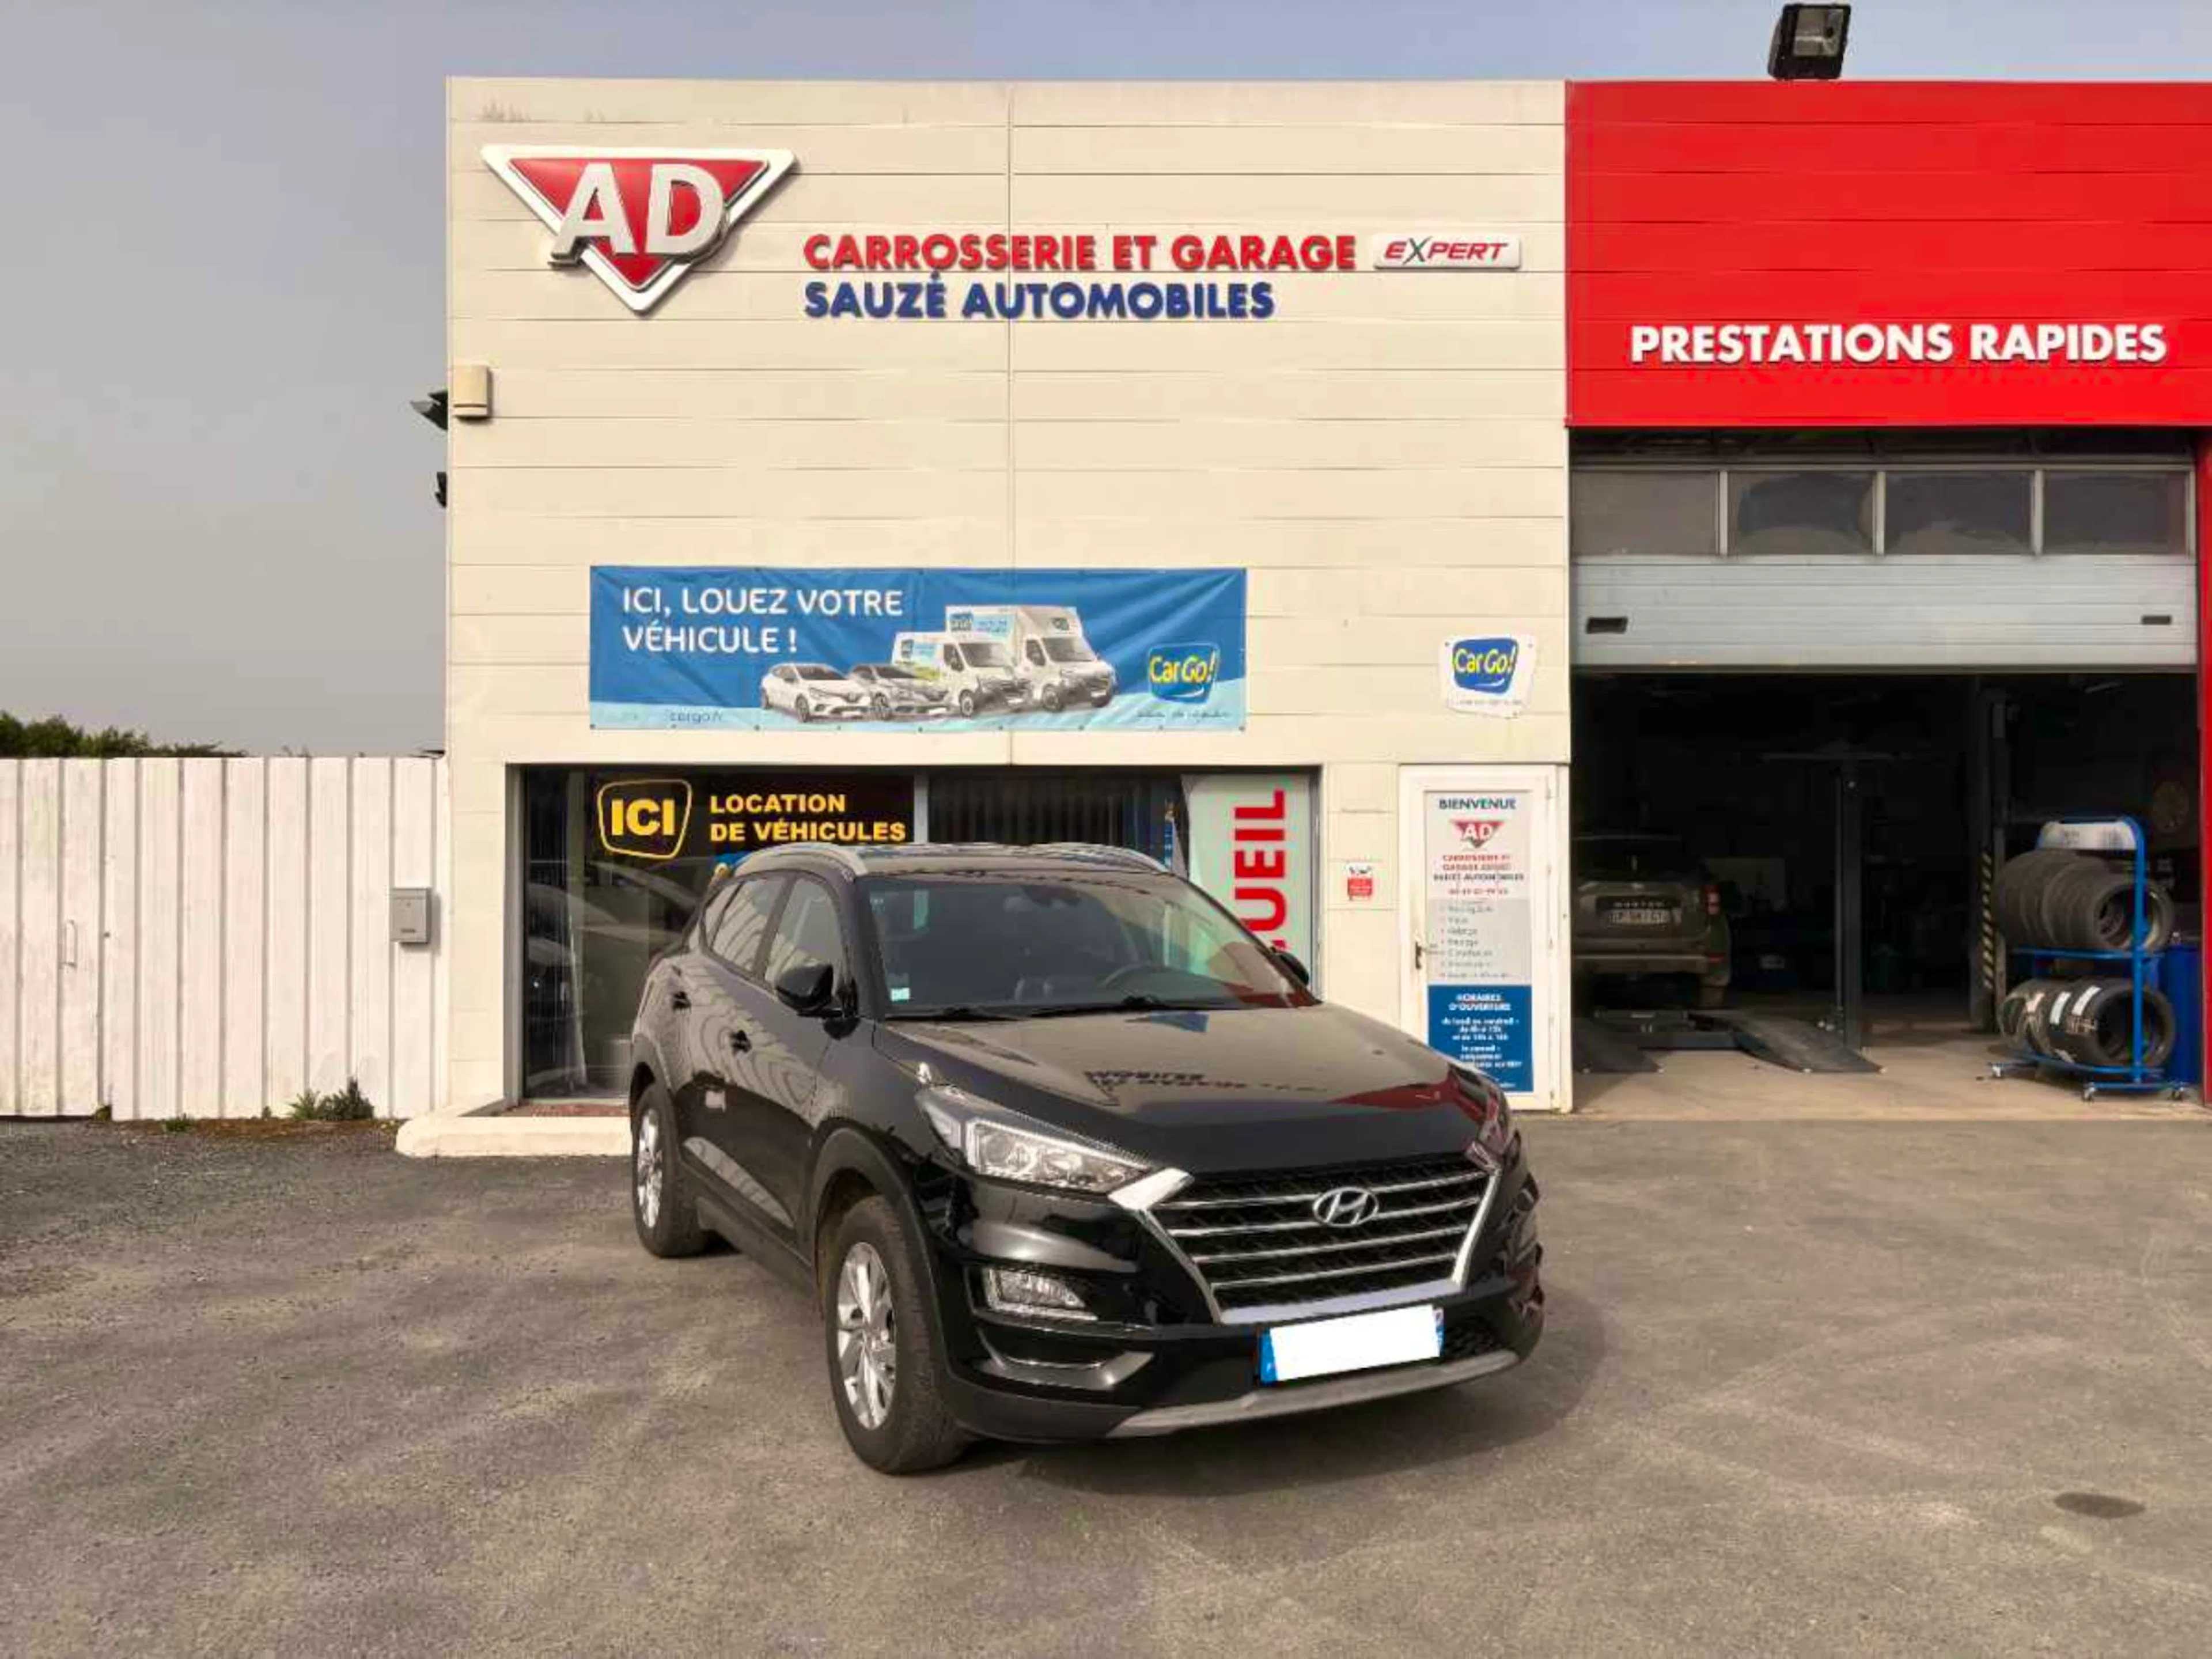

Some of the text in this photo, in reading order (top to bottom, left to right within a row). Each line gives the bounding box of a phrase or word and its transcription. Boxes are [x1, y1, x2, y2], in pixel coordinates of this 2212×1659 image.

[550, 162, 727, 262] AD
[804, 233, 1356, 270] CARROSSERIE ET GARAGE
[804, 270, 1275, 318] SAUZÉ AUTOMOBILES
[1631, 324, 2167, 363] PRESTATIONS RAPIDES
[623, 588, 903, 618] ICI, LOUEZ VOTRE
[623, 620, 779, 653] VÉHICULE
[611, 798, 677, 836] ICI
[710, 793, 846, 814] LOCATION
[1438, 798, 1517, 810] BIENVENUE
[710, 818, 907, 842] DE VÉHICULES
[1463, 824, 1492, 839] AD
[1234, 789, 1287, 950] UEIL
